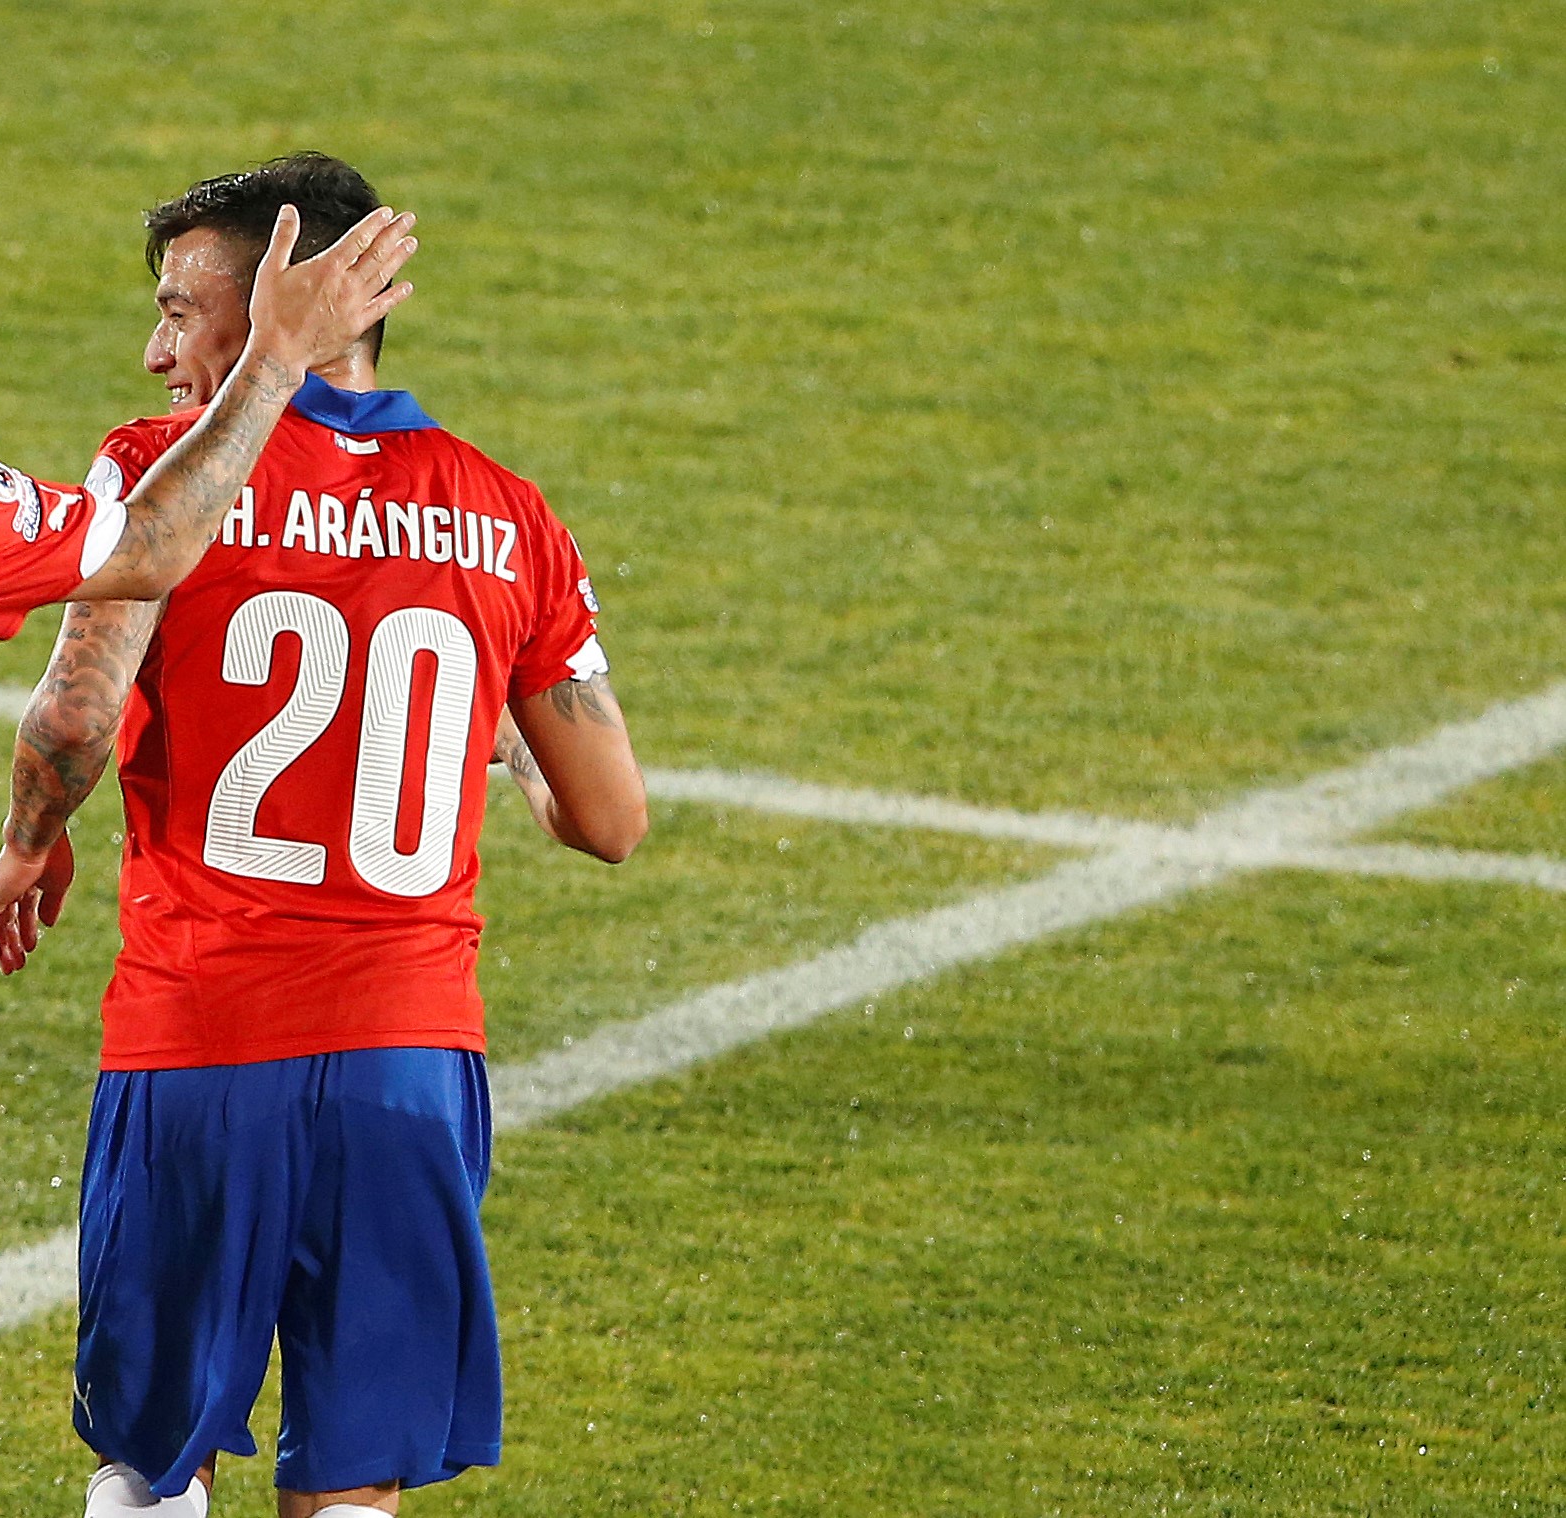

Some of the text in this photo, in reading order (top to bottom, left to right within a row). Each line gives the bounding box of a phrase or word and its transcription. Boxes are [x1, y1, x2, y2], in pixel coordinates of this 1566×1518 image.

[212, 486, 517, 582] H. ARÁNGUIZ
[203, 590, 478, 897] 20
